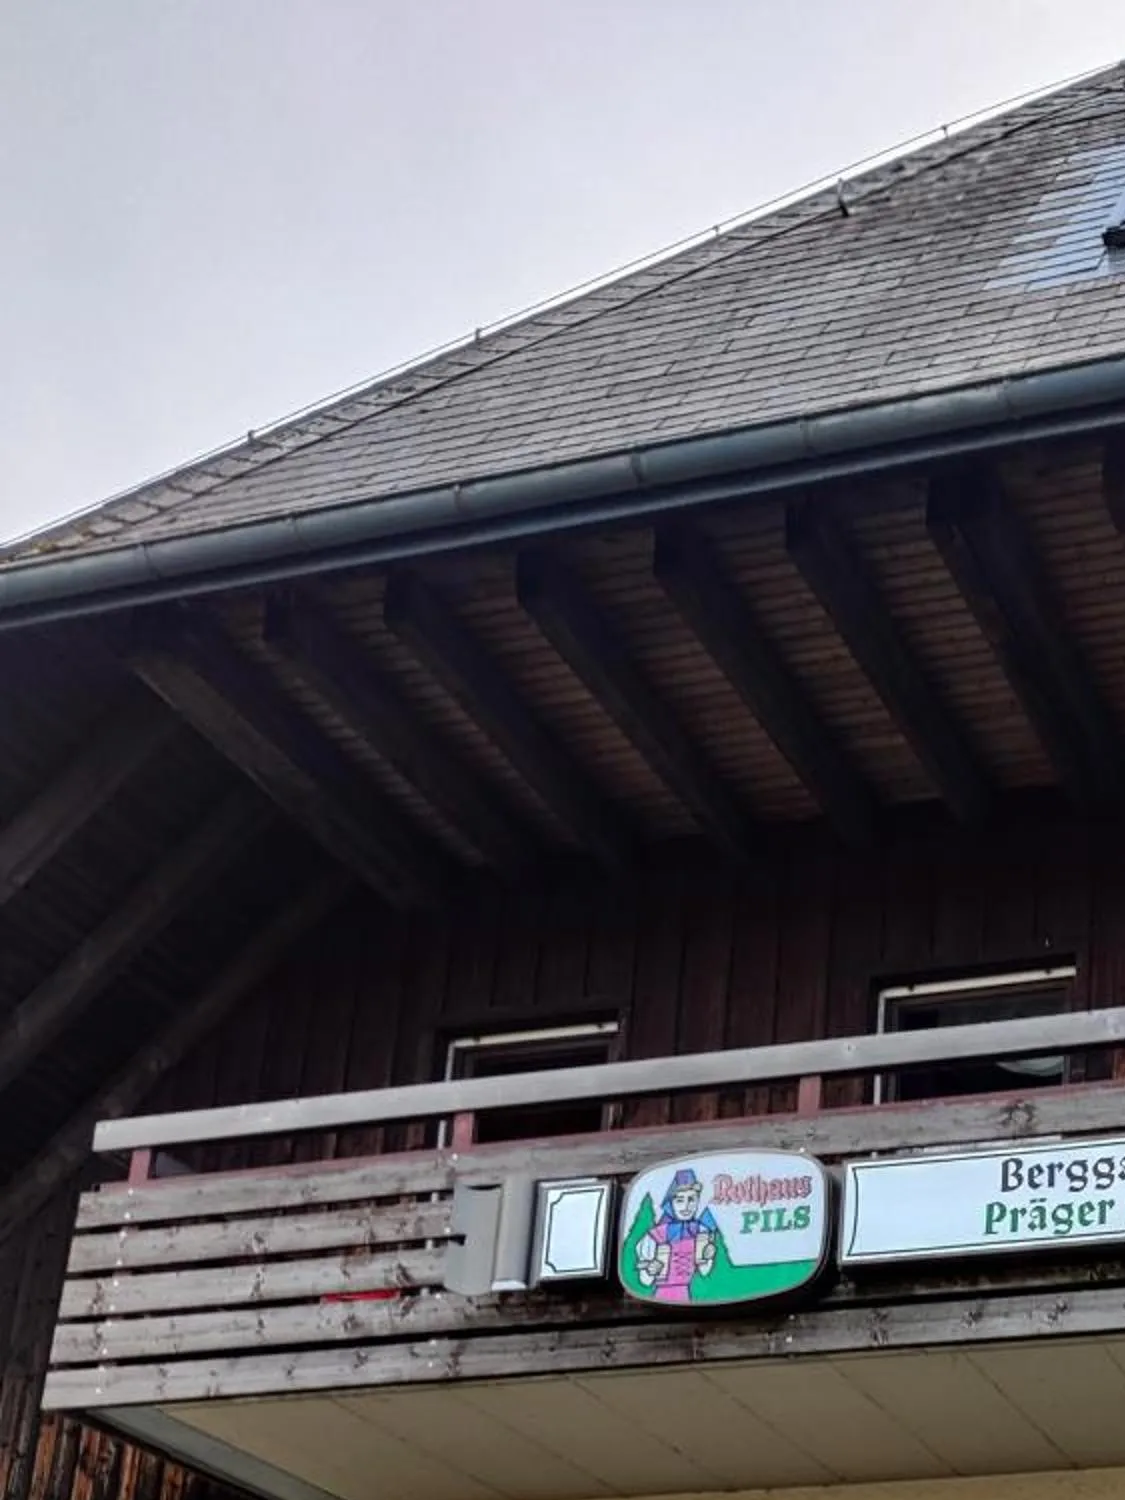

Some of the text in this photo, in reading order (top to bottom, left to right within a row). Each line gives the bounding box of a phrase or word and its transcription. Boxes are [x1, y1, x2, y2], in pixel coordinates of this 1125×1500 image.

[709, 1173, 813, 1207] Rothaus
[739, 1205, 811, 1234] PILS
[982, 1197, 1116, 1235] Präger
